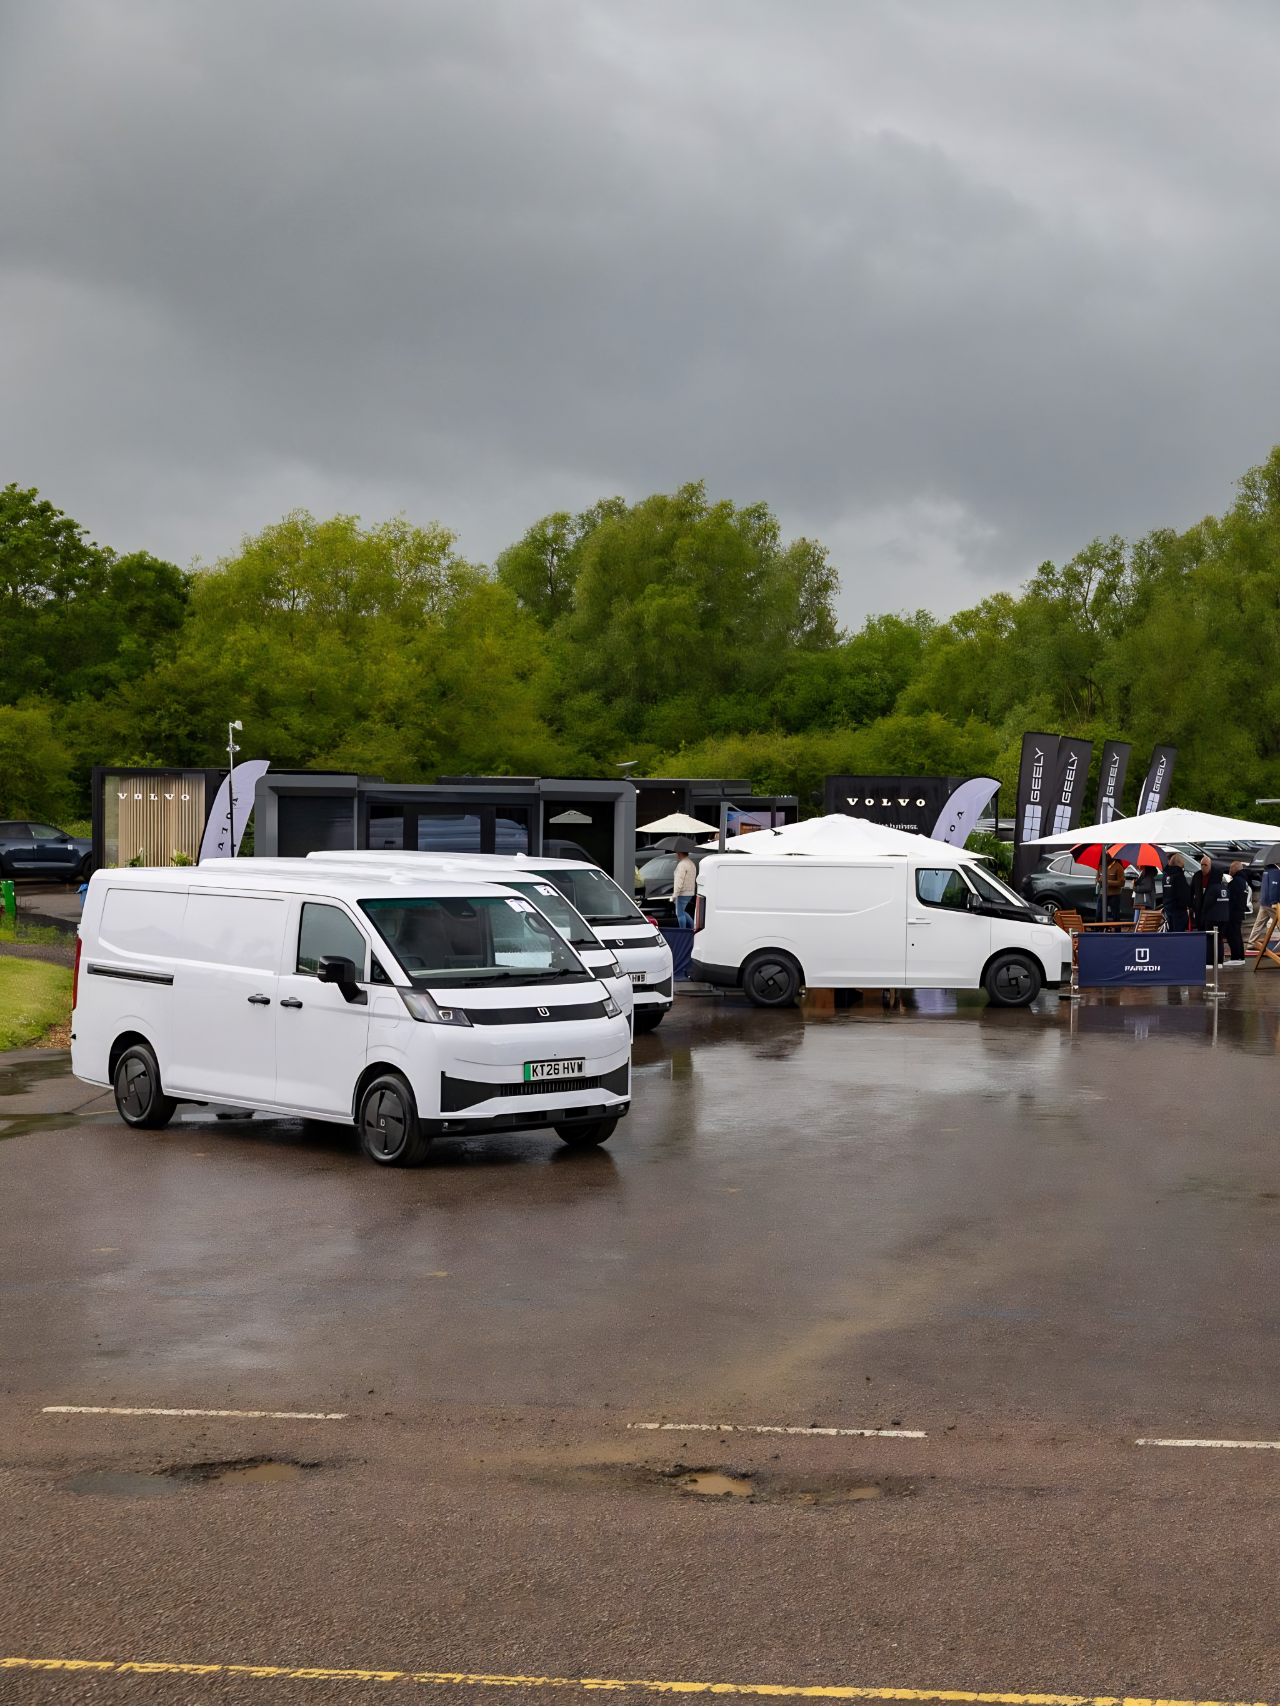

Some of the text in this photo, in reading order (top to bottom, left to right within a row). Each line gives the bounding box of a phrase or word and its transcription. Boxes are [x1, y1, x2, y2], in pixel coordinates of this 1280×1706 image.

[1030, 747, 1045, 802] GEELY
[1061, 751, 1078, 804] GEELY
[1106, 752, 1120, 796] GEELY
[1152, 754, 1167, 793] GEELY
[117, 792, 190, 801] VOLVO
[846, 797, 926, 807] VOLVO
[216, 797, 239, 856] VOLV
[531, 1063, 560, 1078] KT26
